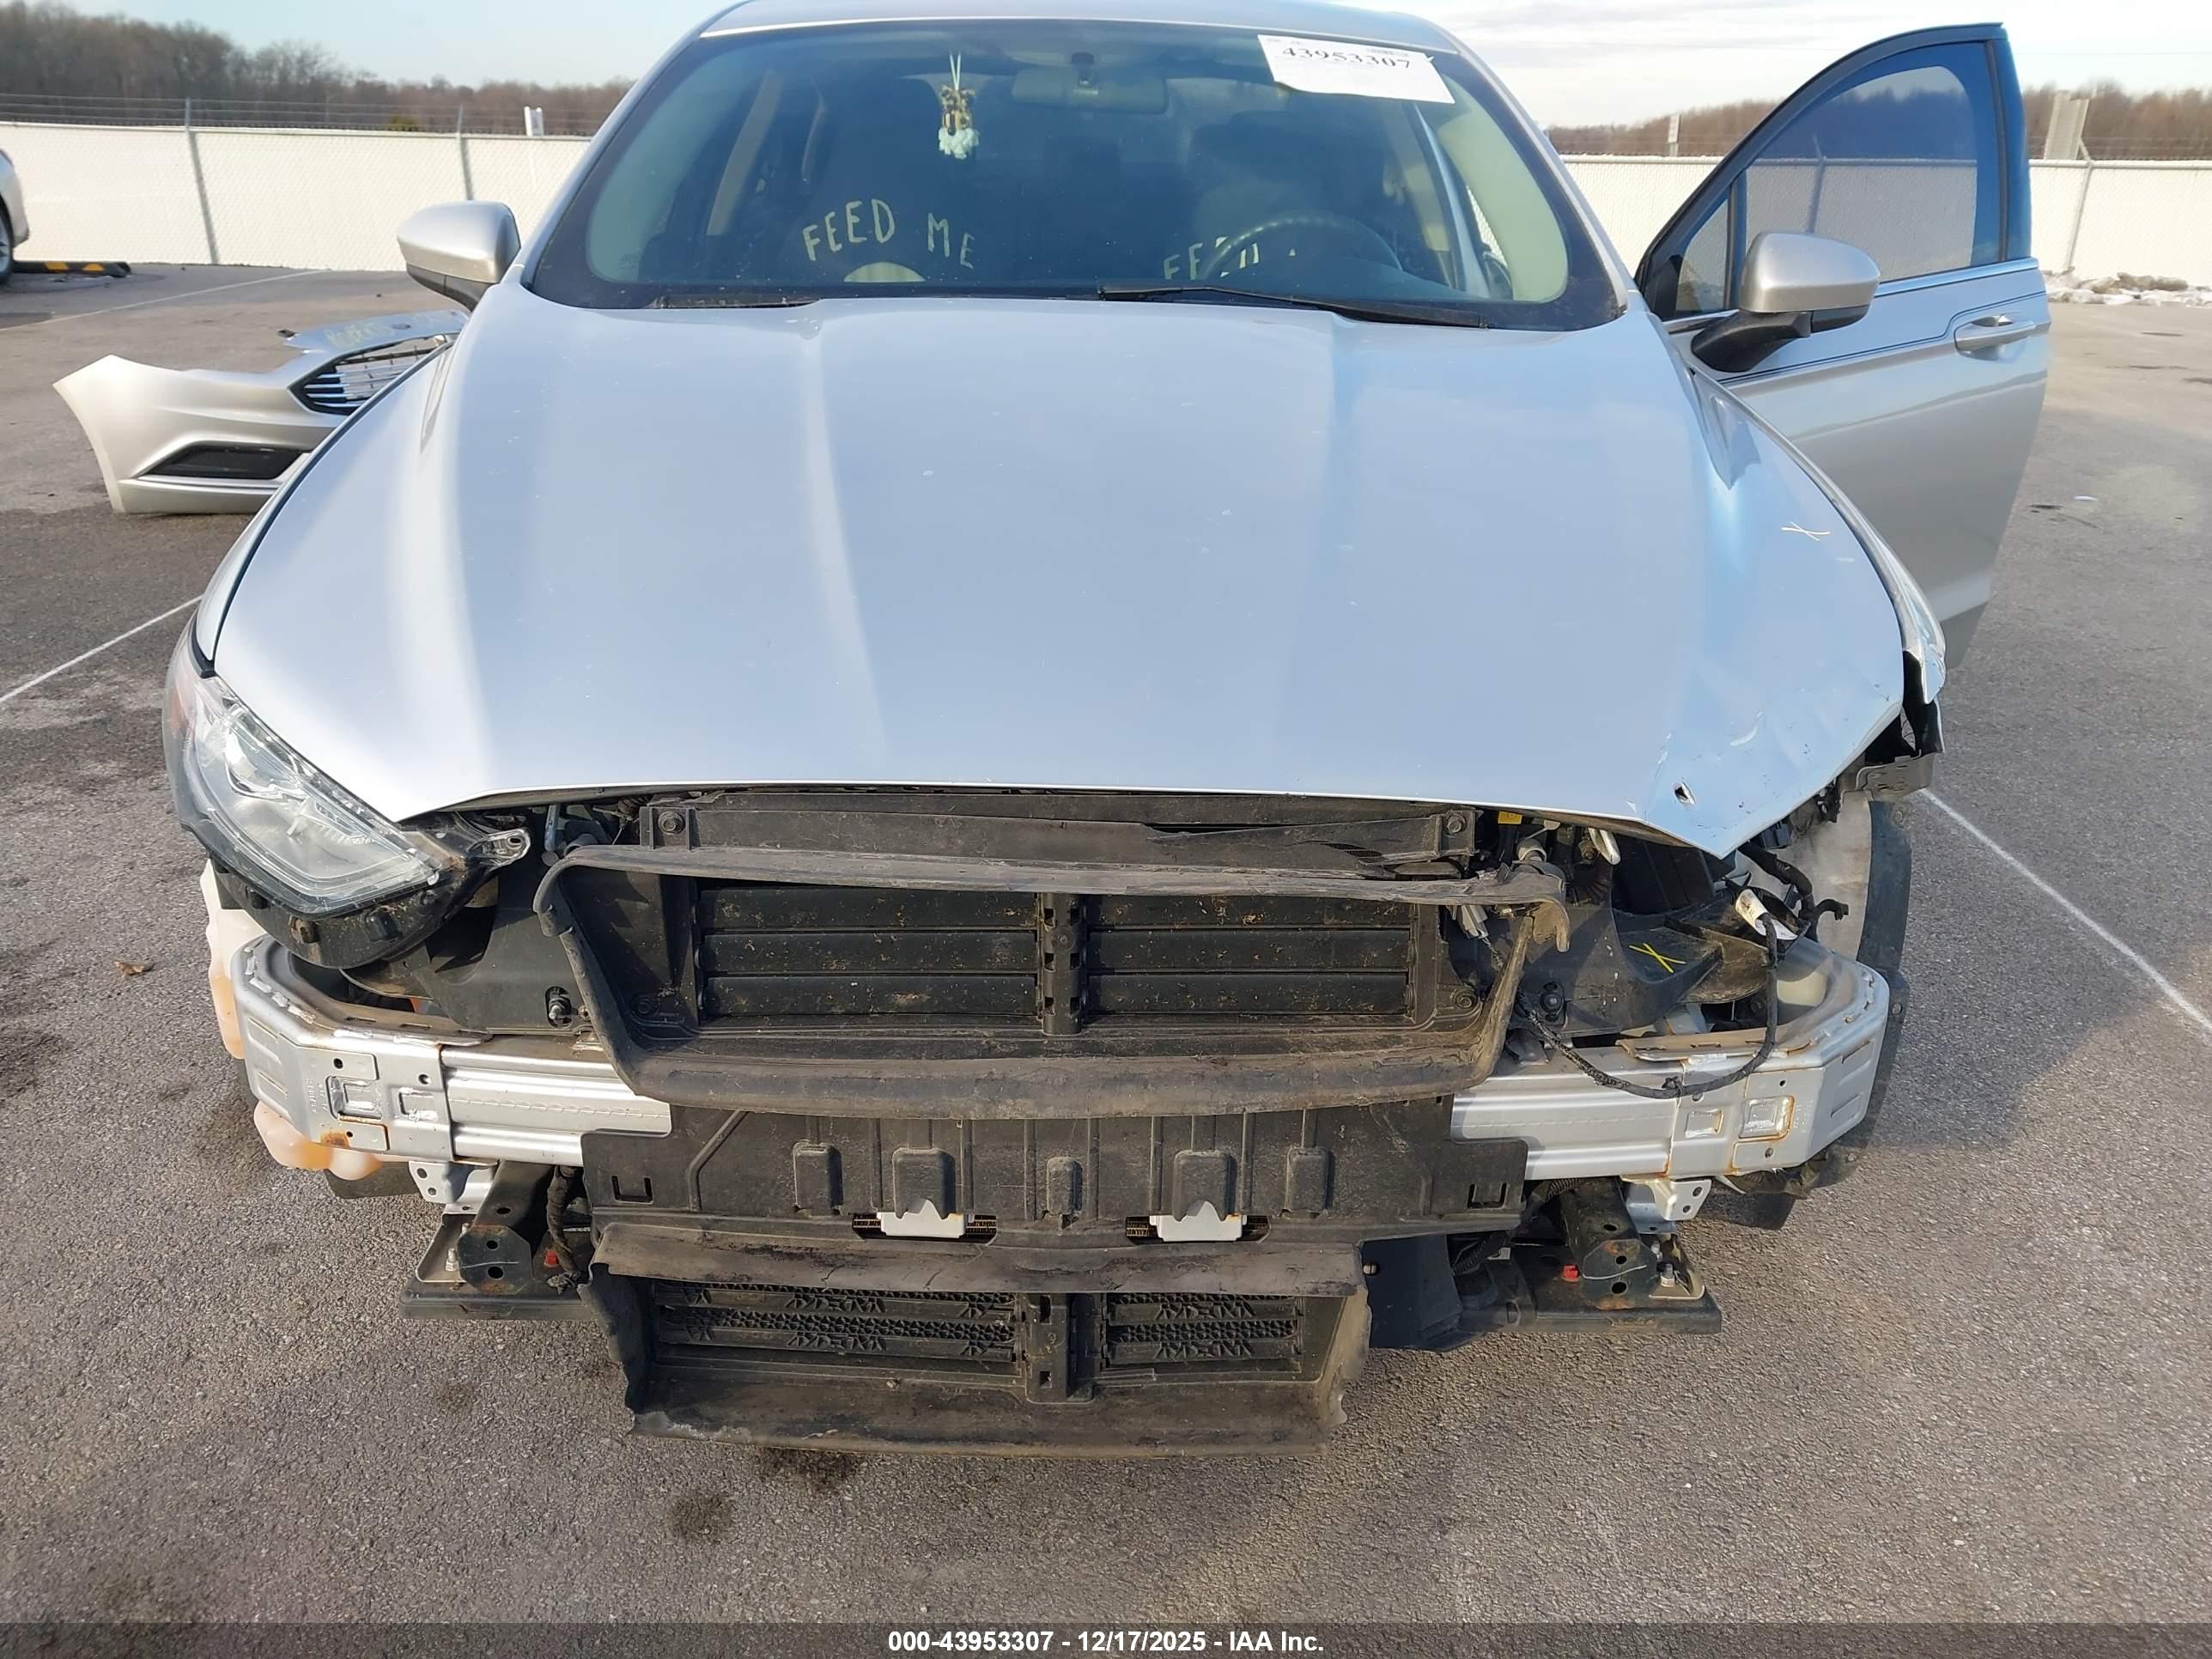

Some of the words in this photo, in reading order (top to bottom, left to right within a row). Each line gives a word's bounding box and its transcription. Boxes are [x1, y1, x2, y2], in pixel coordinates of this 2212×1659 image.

[1283, 47, 1410, 69] 43953307
[803, 199, 895, 261] FEED
[927, 213, 975, 269] ME
